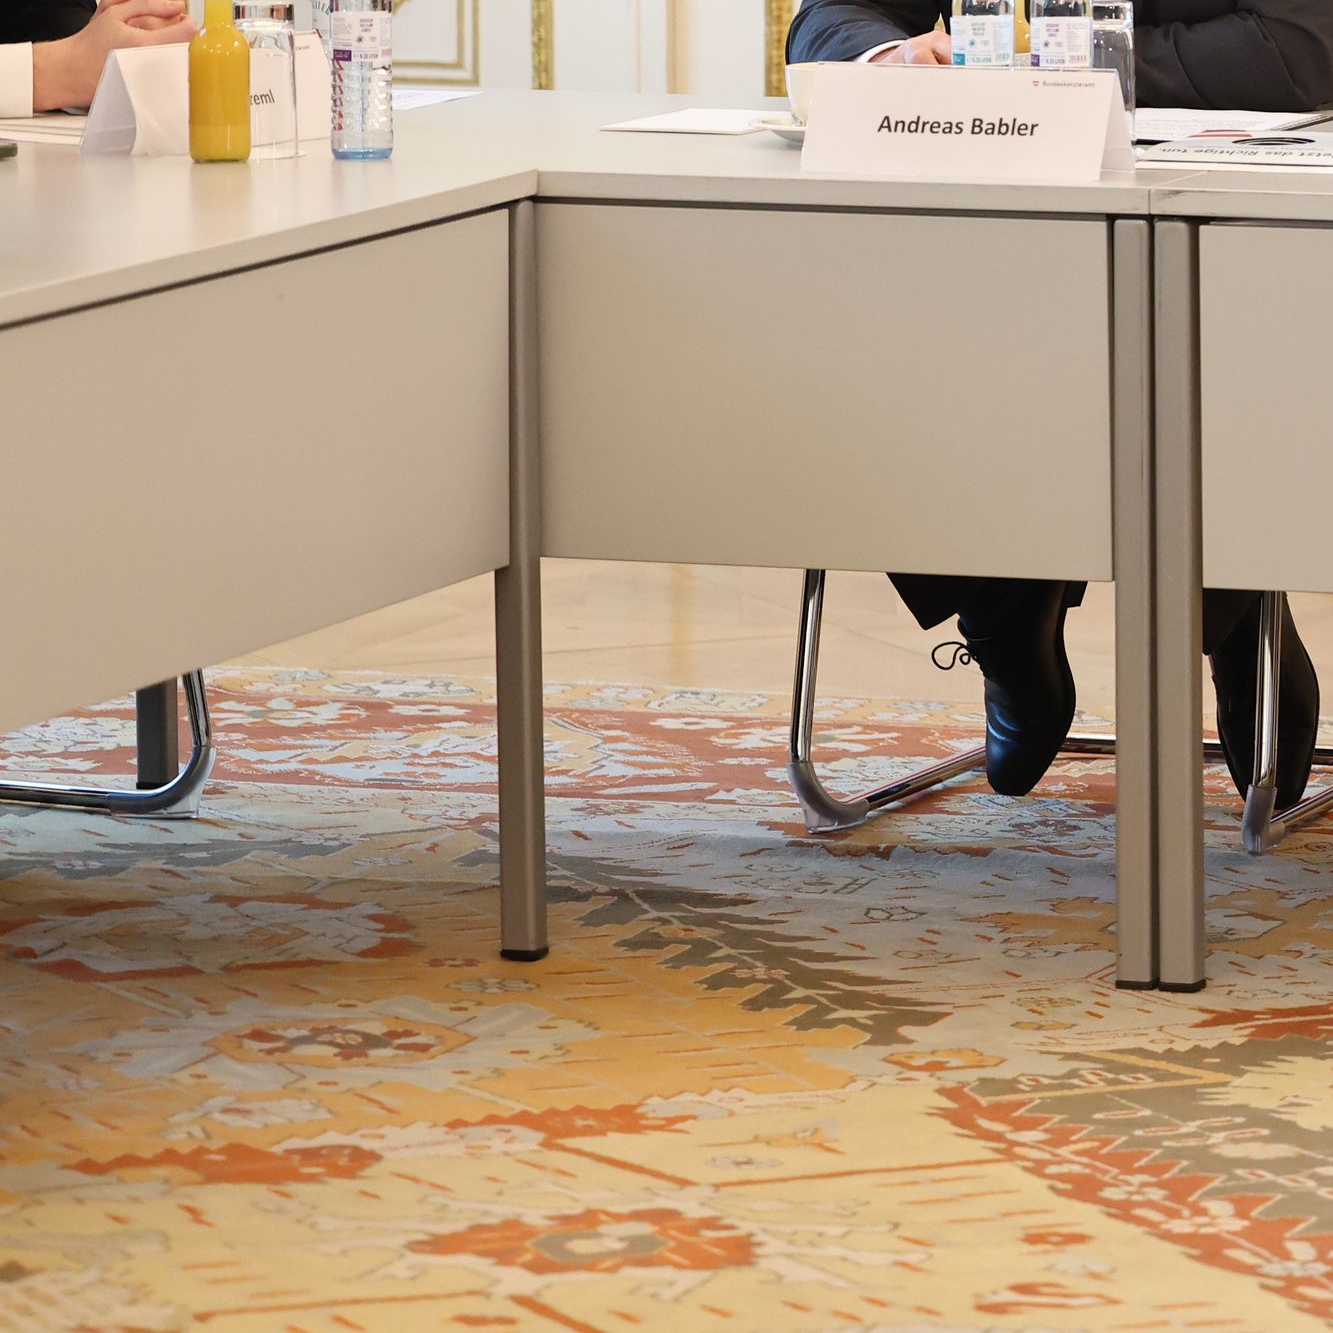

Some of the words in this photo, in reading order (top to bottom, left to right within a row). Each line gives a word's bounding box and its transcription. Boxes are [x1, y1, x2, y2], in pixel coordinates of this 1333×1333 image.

[1042, 80, 1096, 88] Bundeskanzleramt
[877, 115, 964, 135] Andreas
[970, 117, 1039, 137] Babler
[1194, 148, 1258, 156] Richtige
